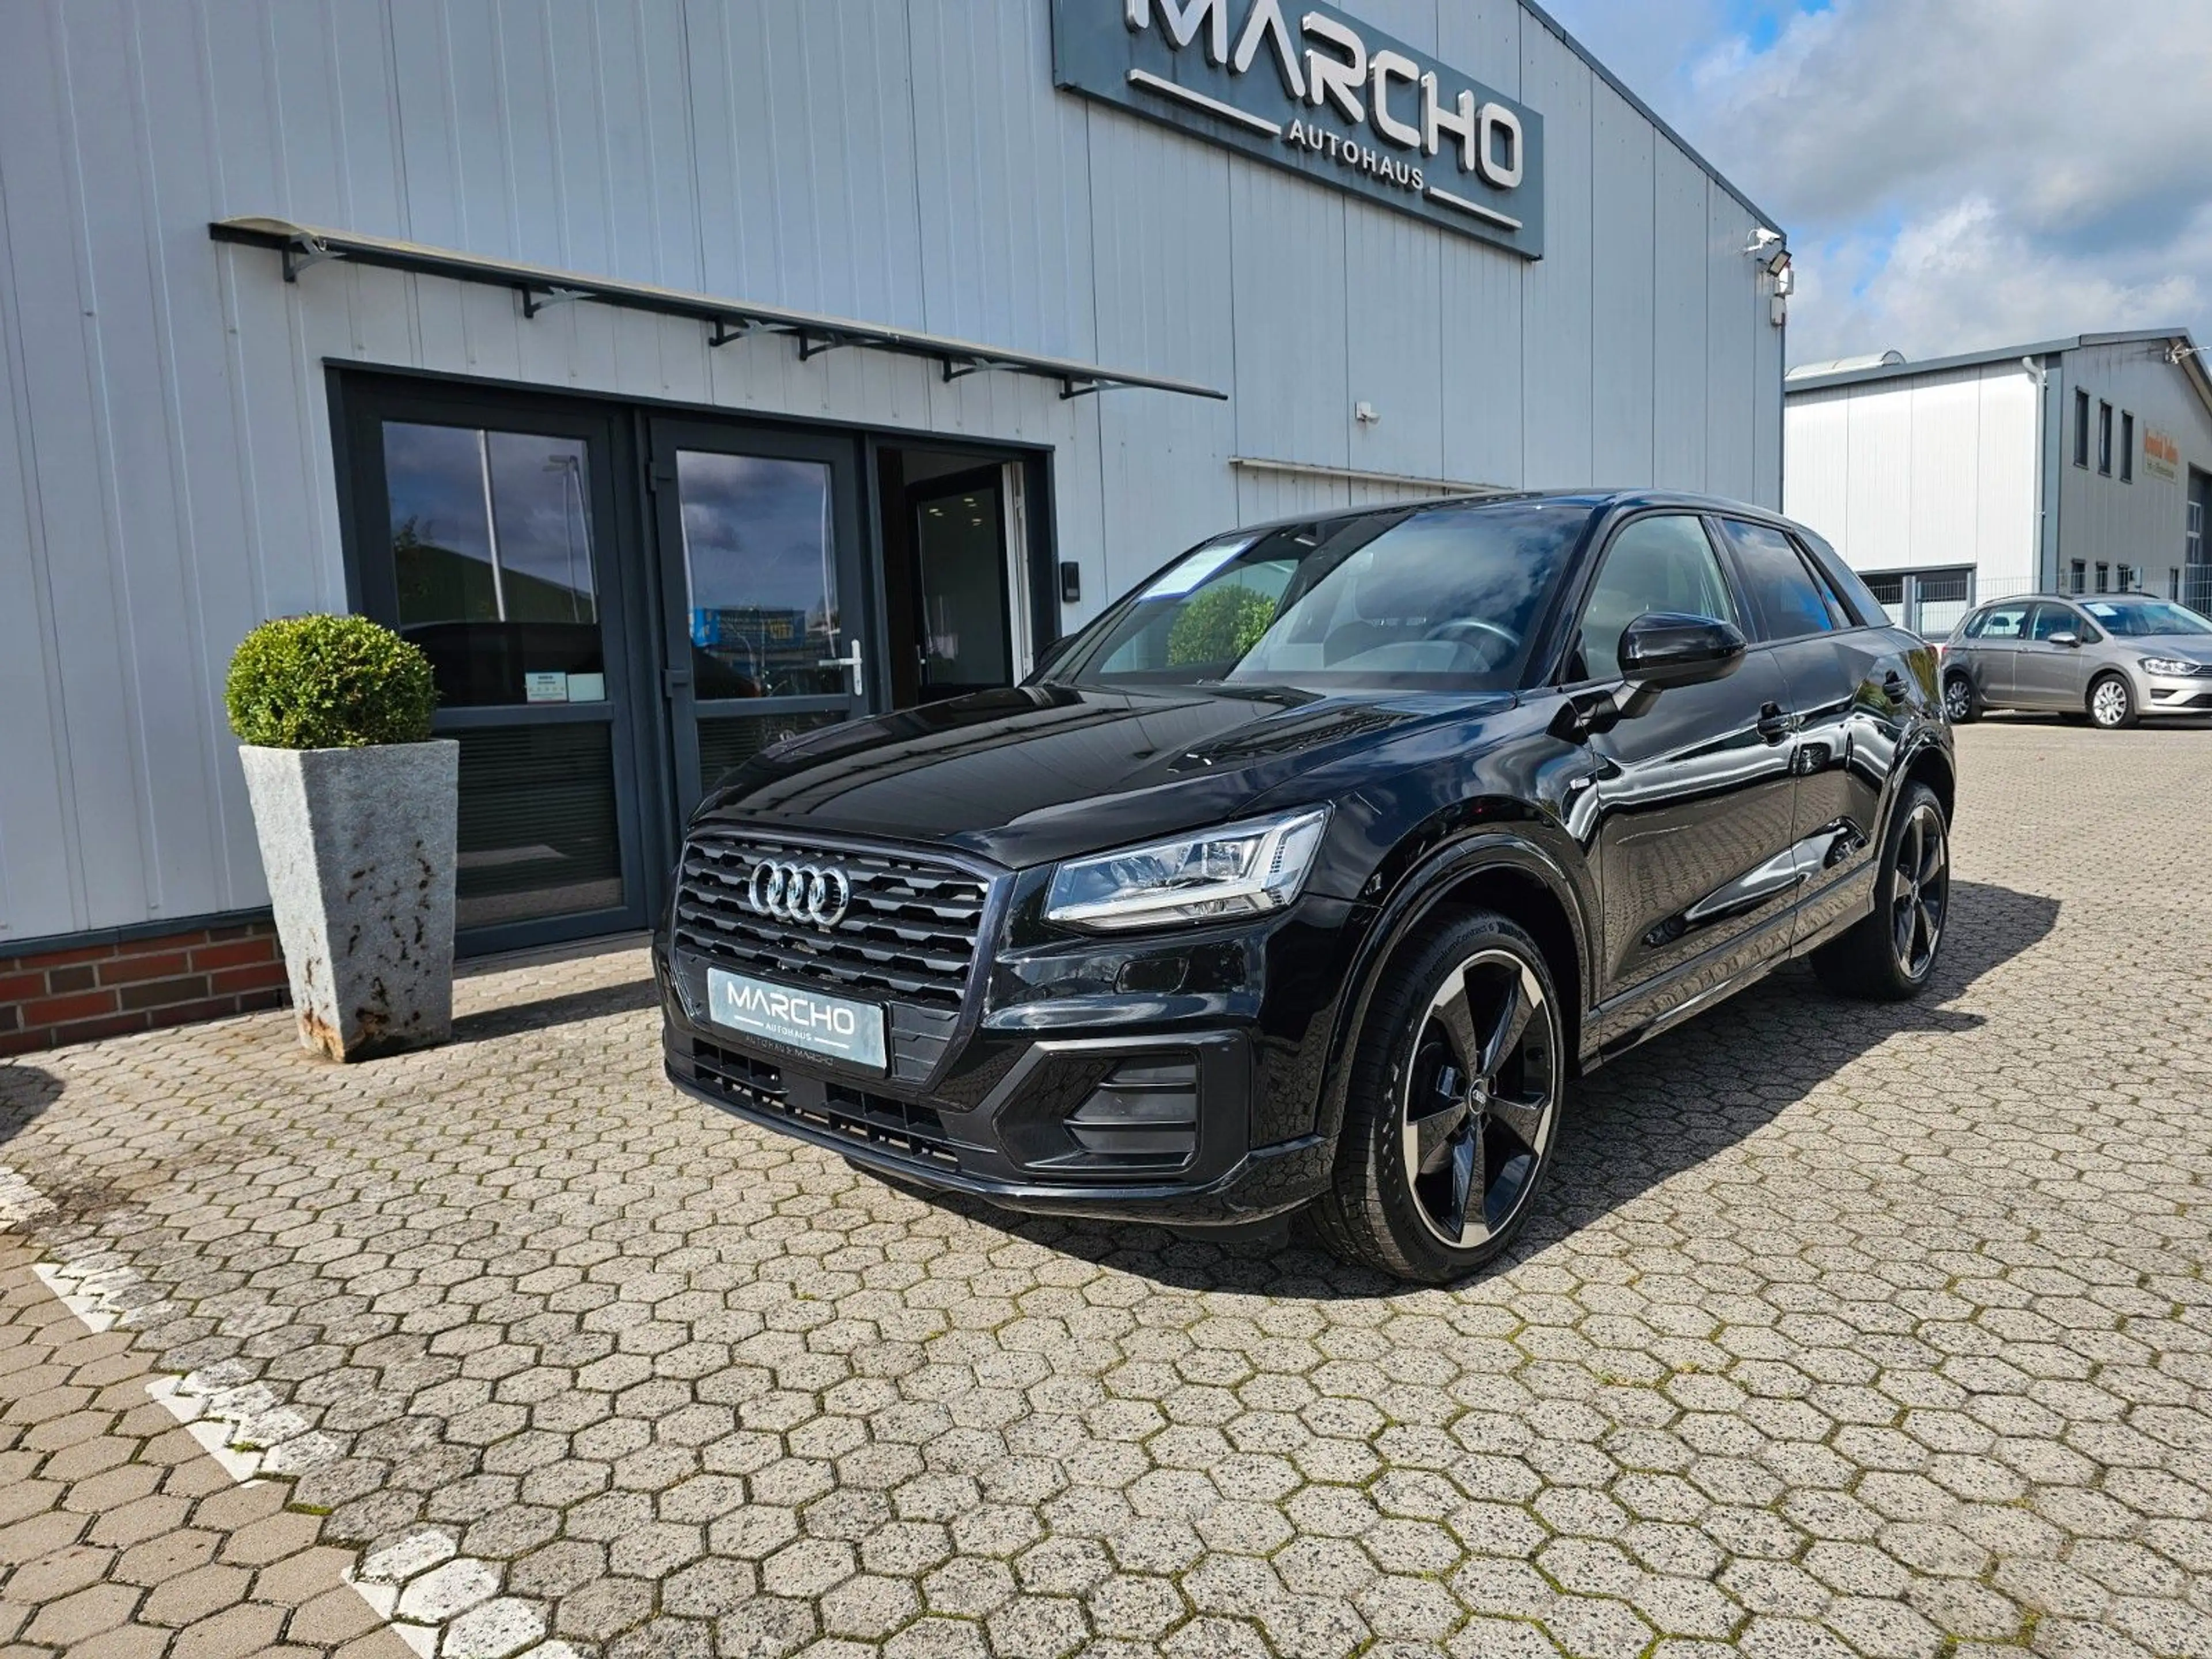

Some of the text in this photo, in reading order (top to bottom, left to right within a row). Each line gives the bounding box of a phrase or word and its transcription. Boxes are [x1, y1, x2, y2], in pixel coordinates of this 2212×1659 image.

[1126, 0, 1522, 188] MARCHO
[1289, 119, 1425, 191] AUTOHAUS
[726, 980, 854, 1035] MARCHO
[765, 1022, 812, 1041] AUTOHAUS
